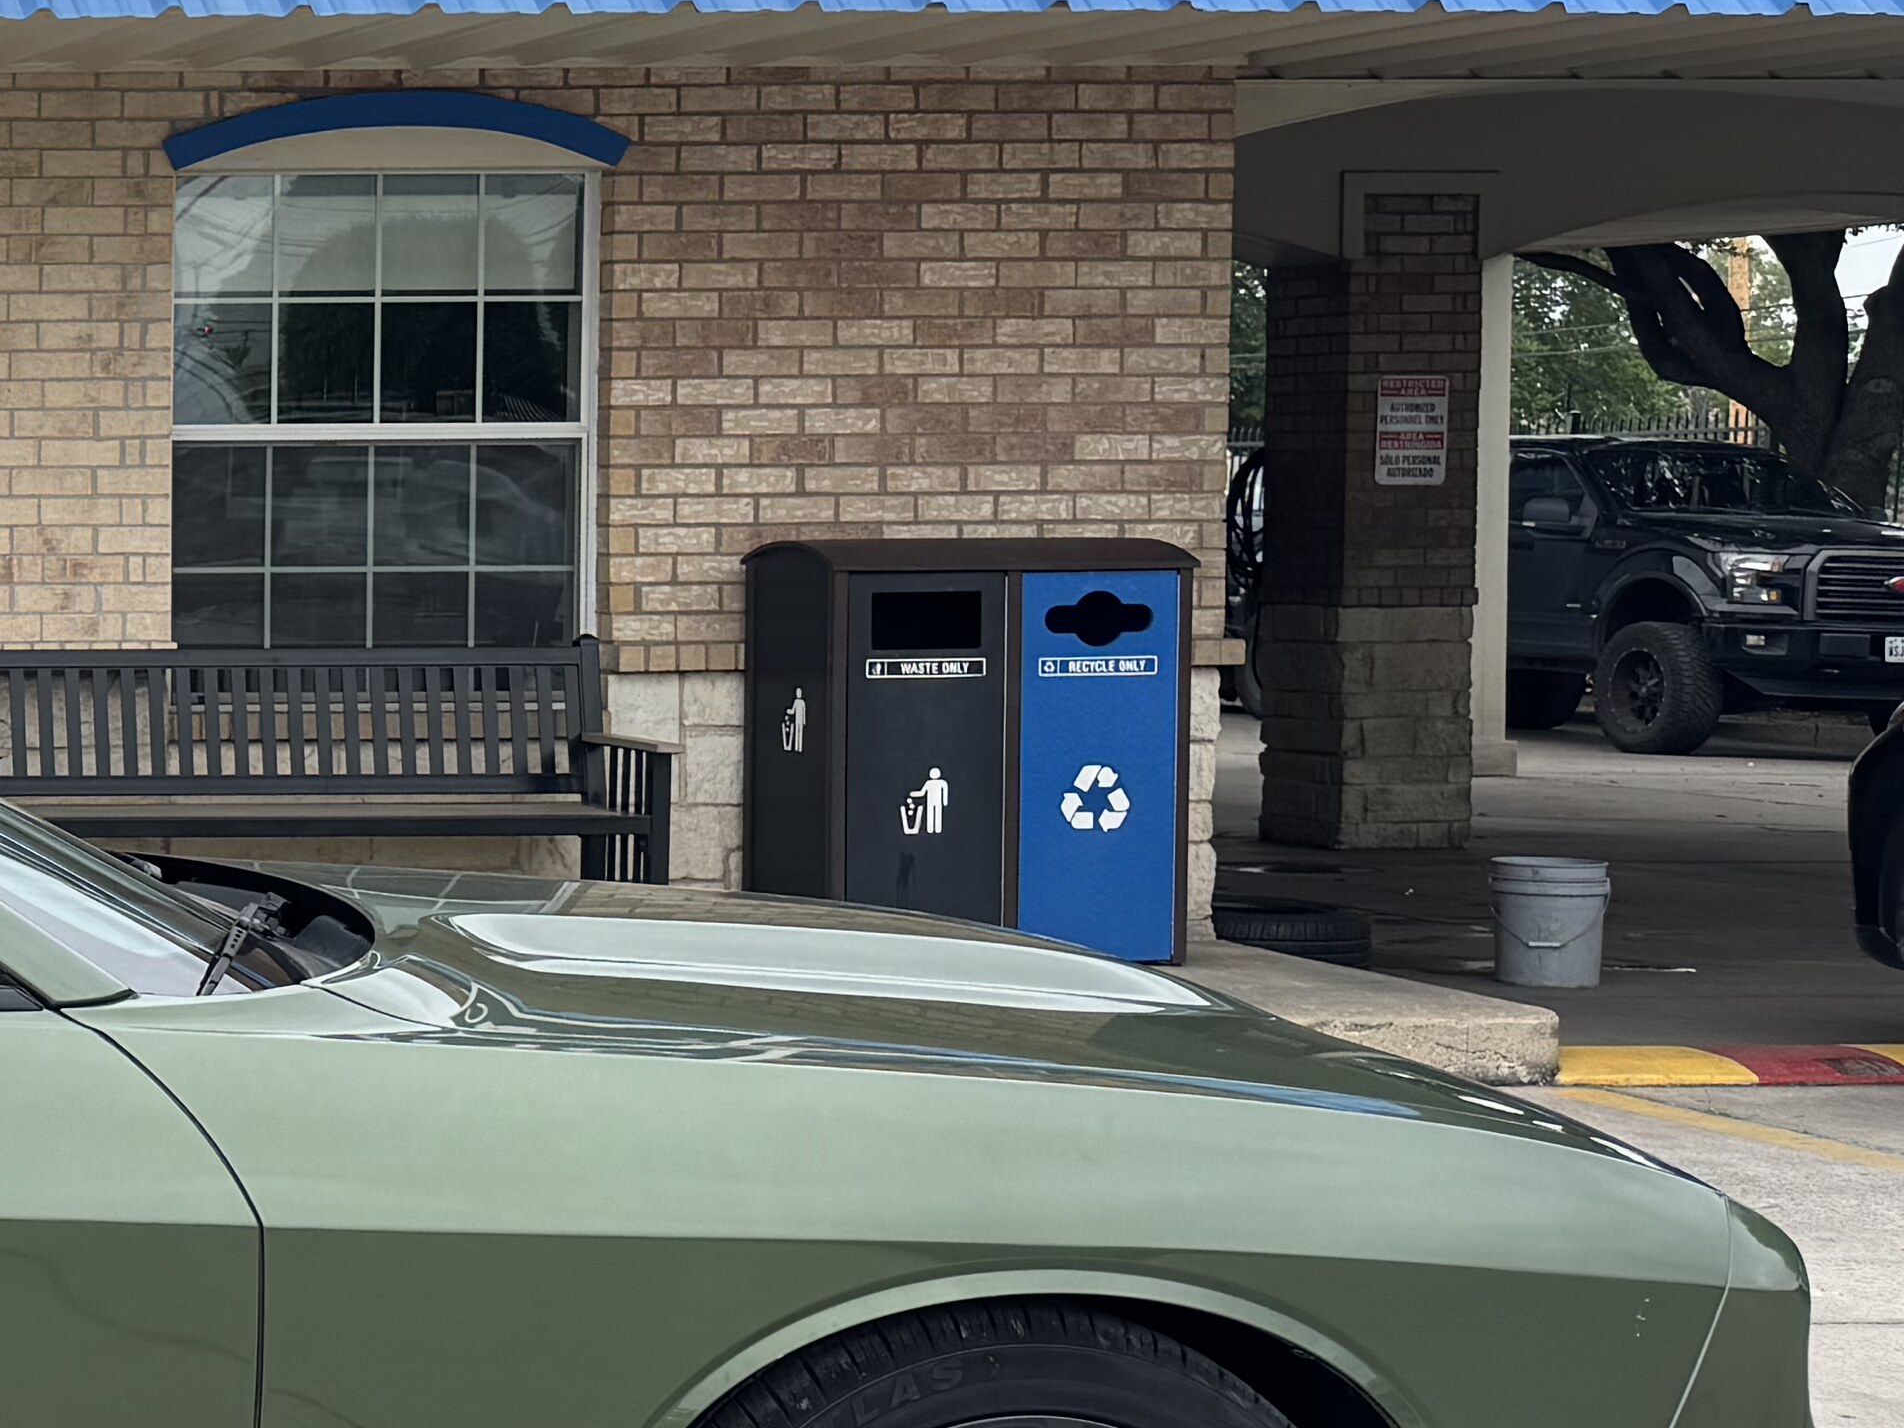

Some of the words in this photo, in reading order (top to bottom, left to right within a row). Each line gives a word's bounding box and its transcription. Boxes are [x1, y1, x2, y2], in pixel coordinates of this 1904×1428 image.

[1382, 379, 1445, 388] RESTRICTED
[1399, 388, 1427, 396] AREA
[900, 662, 938, 675] WASTE
[941, 661, 970, 674] ONLY
[1068, 660, 1115, 673] RECYCLE
[1118, 659, 1146, 672] ONLY
